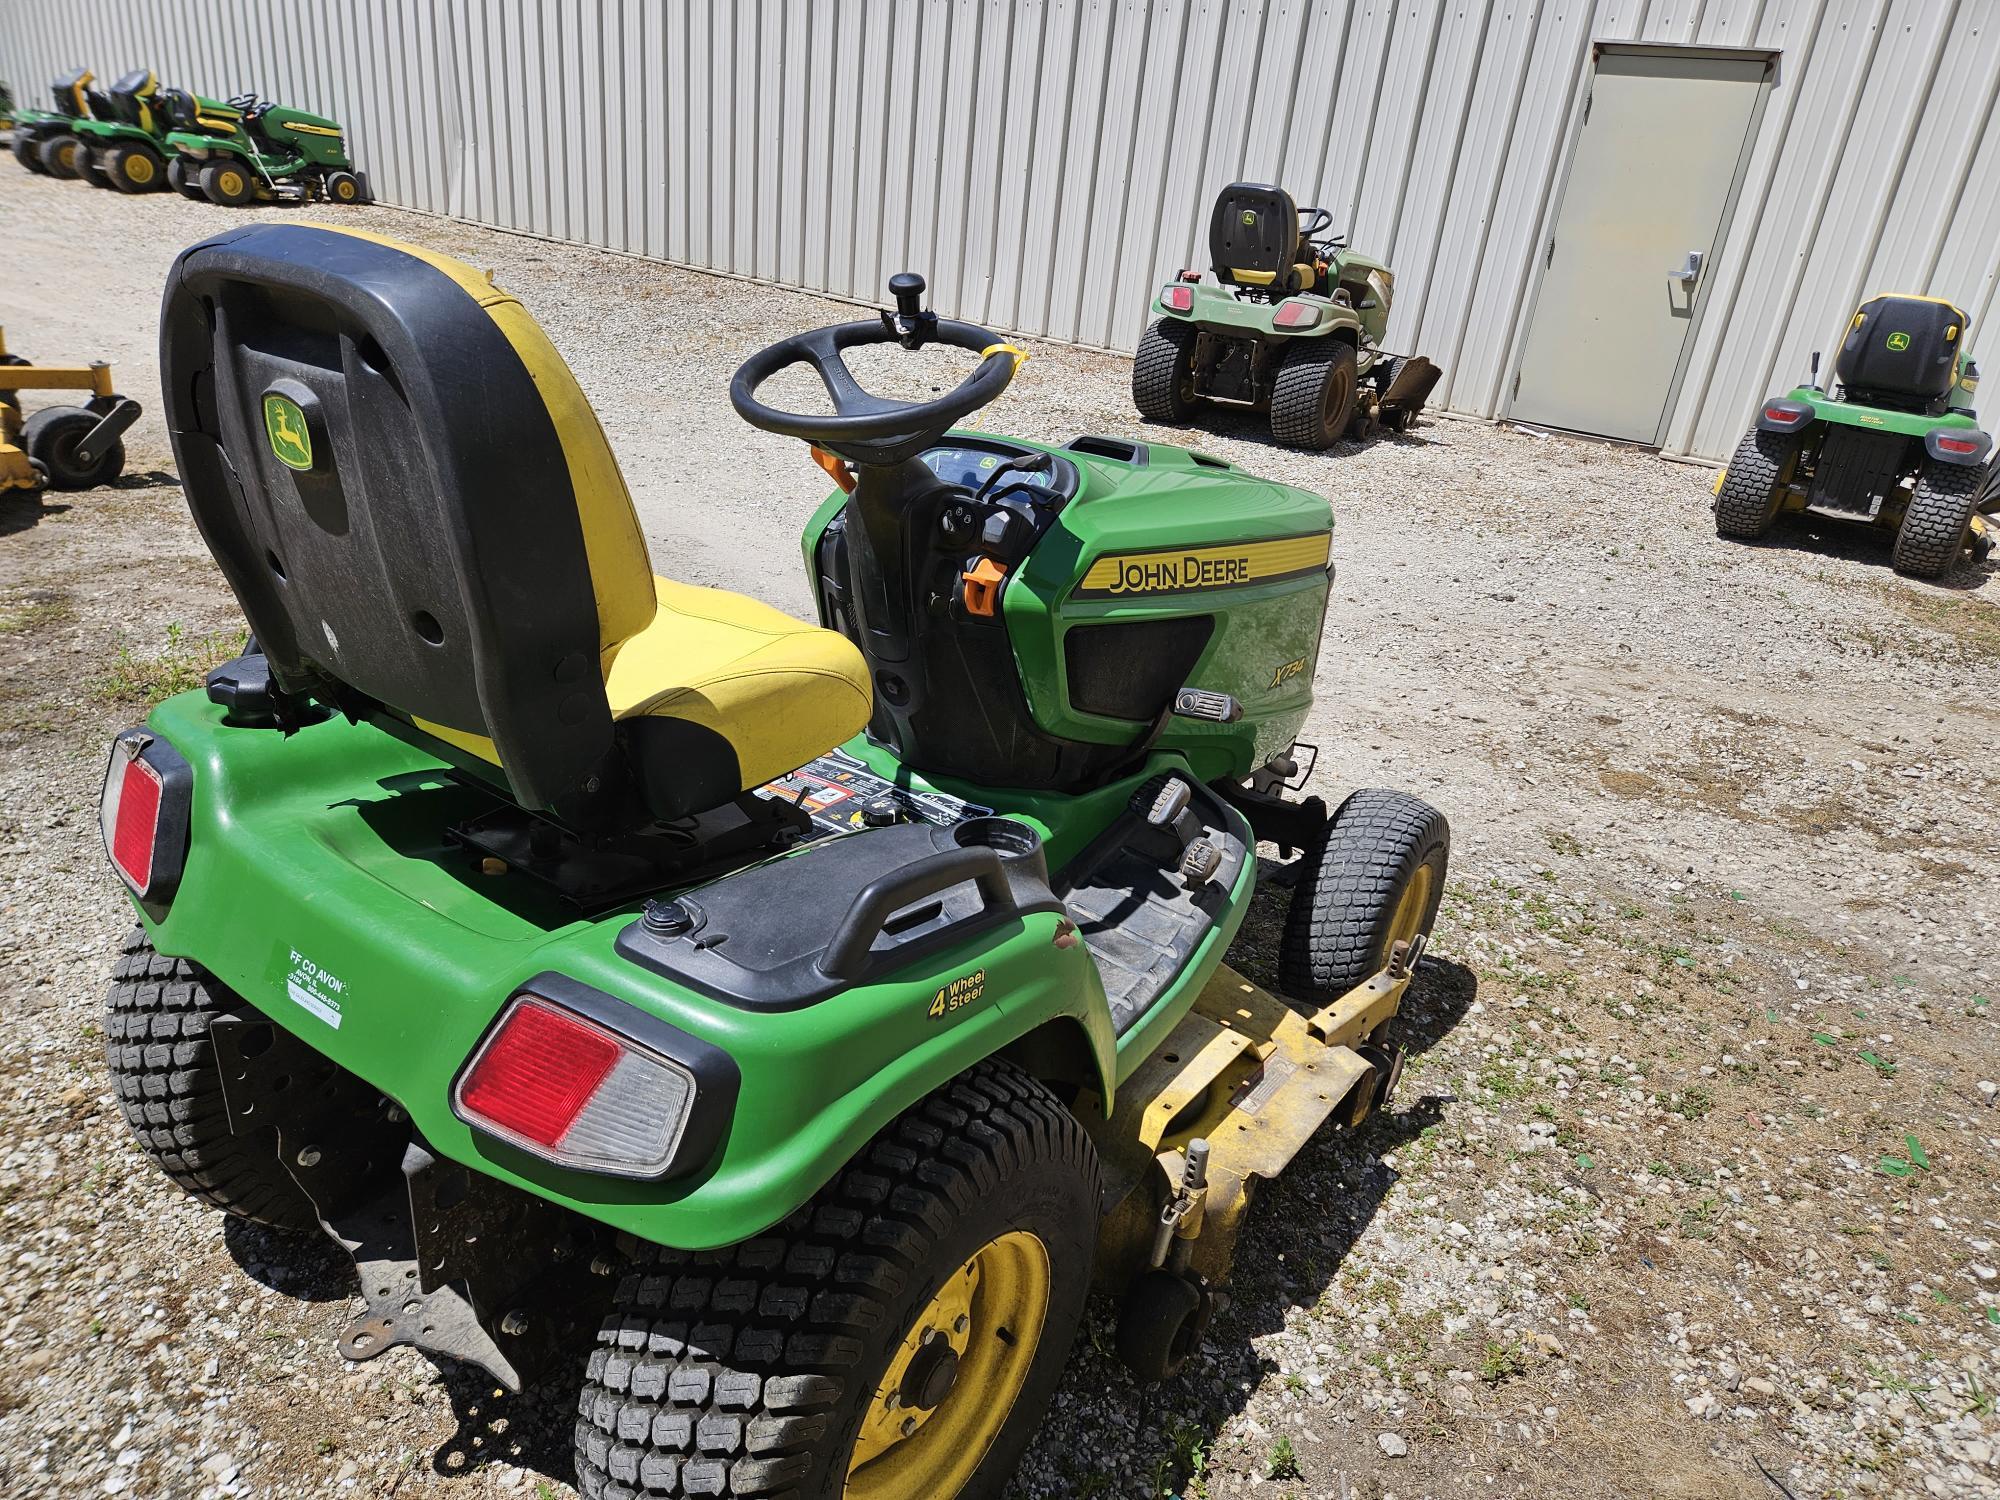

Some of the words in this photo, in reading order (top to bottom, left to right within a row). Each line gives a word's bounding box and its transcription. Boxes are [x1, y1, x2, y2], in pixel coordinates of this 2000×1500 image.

[1109, 560, 1178, 593] JOHN
[1183, 556, 1250, 587] DEERE
[1269, 657, 1306, 688] X734
[302, 959, 316, 975] CO
[316, 969, 343, 993] AVON
[929, 989, 946, 1016] 4
[949, 969, 985, 997] Wheel
[949, 985, 984, 1012] Steer
